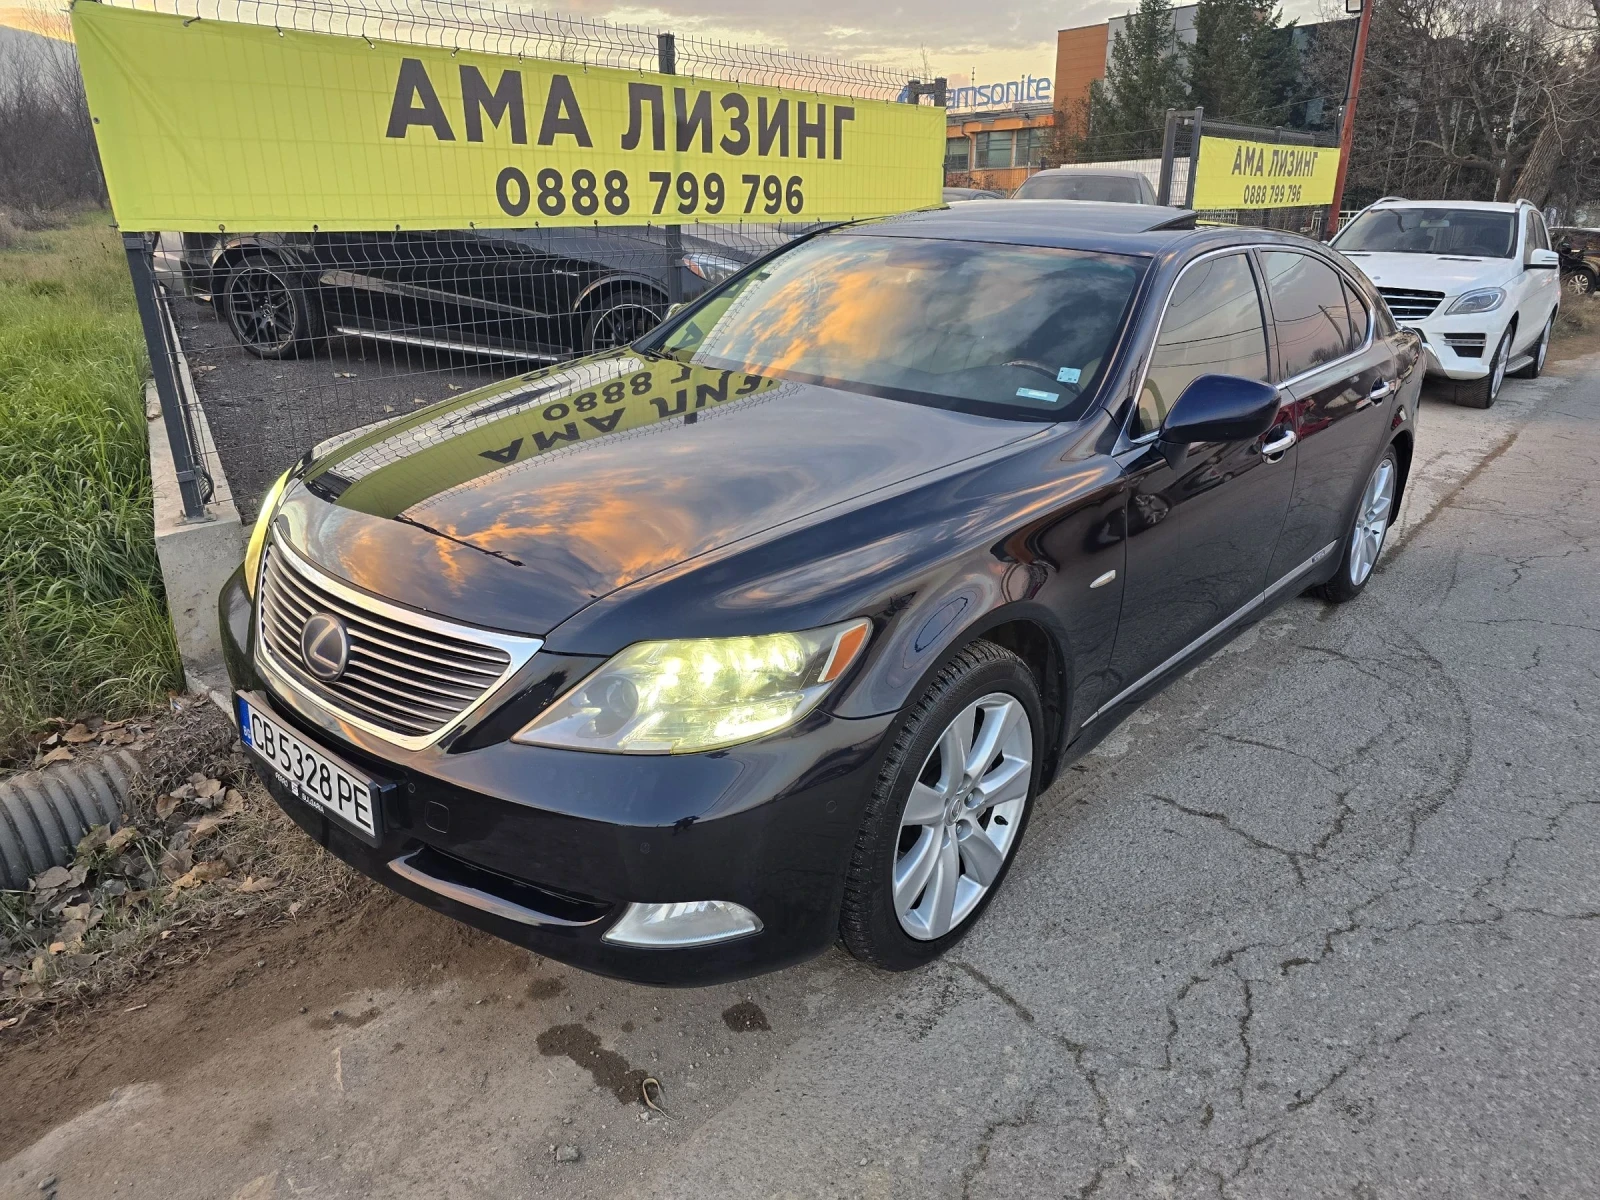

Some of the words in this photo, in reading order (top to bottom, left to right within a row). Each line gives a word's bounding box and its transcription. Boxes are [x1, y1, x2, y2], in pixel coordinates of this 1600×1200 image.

[386, 58, 593, 147] АМА
[621, 82, 855, 160] ЛИЗИНГ
[942, 74, 1051, 109] amsonite
[1231, 146, 1264, 176] АМА
[1268, 149, 1319, 177] ЛИЗИНГ
[496, 167, 630, 217] 0888
[649, 171, 725, 215] 799
[742, 174, 804, 215] 796
[1243, 184, 1267, 204] 0888
[1269, 184, 1286, 204] 799
[1287, 184, 1302, 203] 796
[252, 713, 276, 760] CB
[279, 732, 333, 802] 5328
[337, 772, 372, 830] PE
